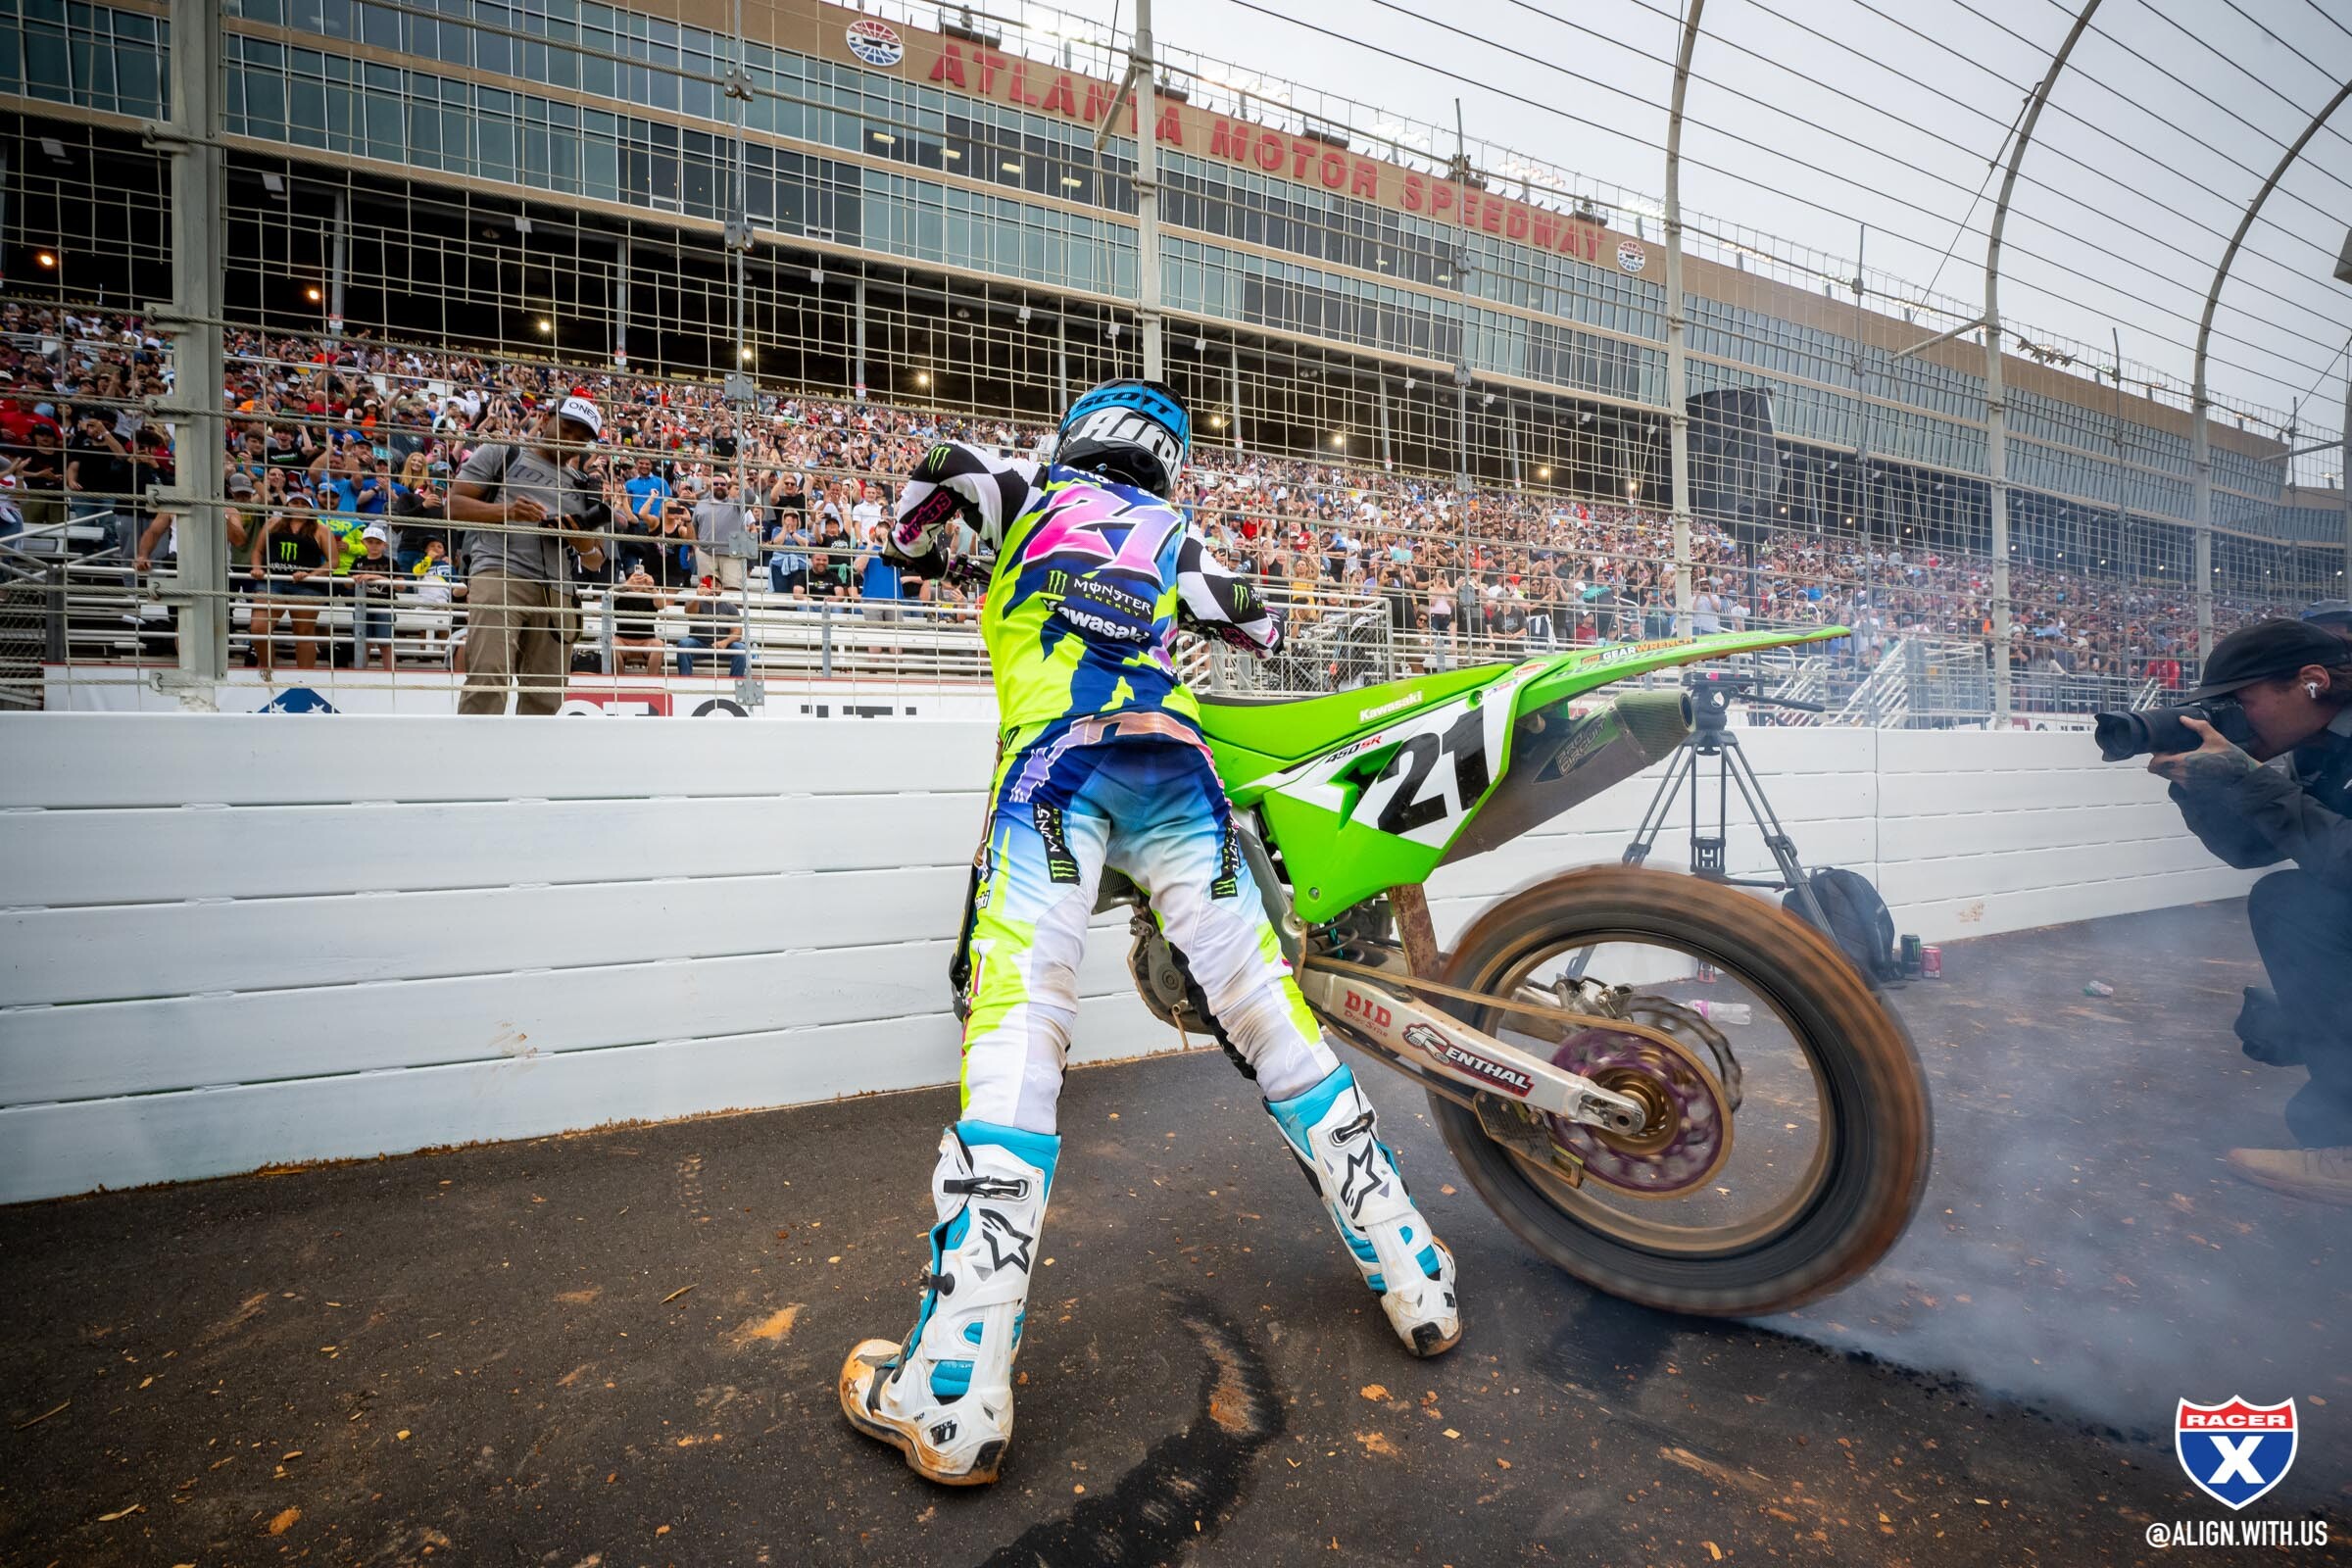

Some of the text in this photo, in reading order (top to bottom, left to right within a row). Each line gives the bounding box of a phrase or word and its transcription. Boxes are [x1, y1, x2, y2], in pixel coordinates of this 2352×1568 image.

[1209, 119, 1377, 200] MOTOR
[1399, 175, 1606, 262] SPEEDWAY
[1074, 392, 1174, 416] SCOTT
[1022, 483, 1183, 588] 21
[1073, 578, 1152, 615] MONSTER
[1084, 593, 1140, 617] ENERGY
[1042, 599, 1151, 643] Kawasaki
[1602, 637, 1693, 661] GEARWRENCH
[1359, 691, 1423, 723] Kawasaki
[1378, 705, 1491, 836] 21
[1035, 803, 1061, 853] MONS
